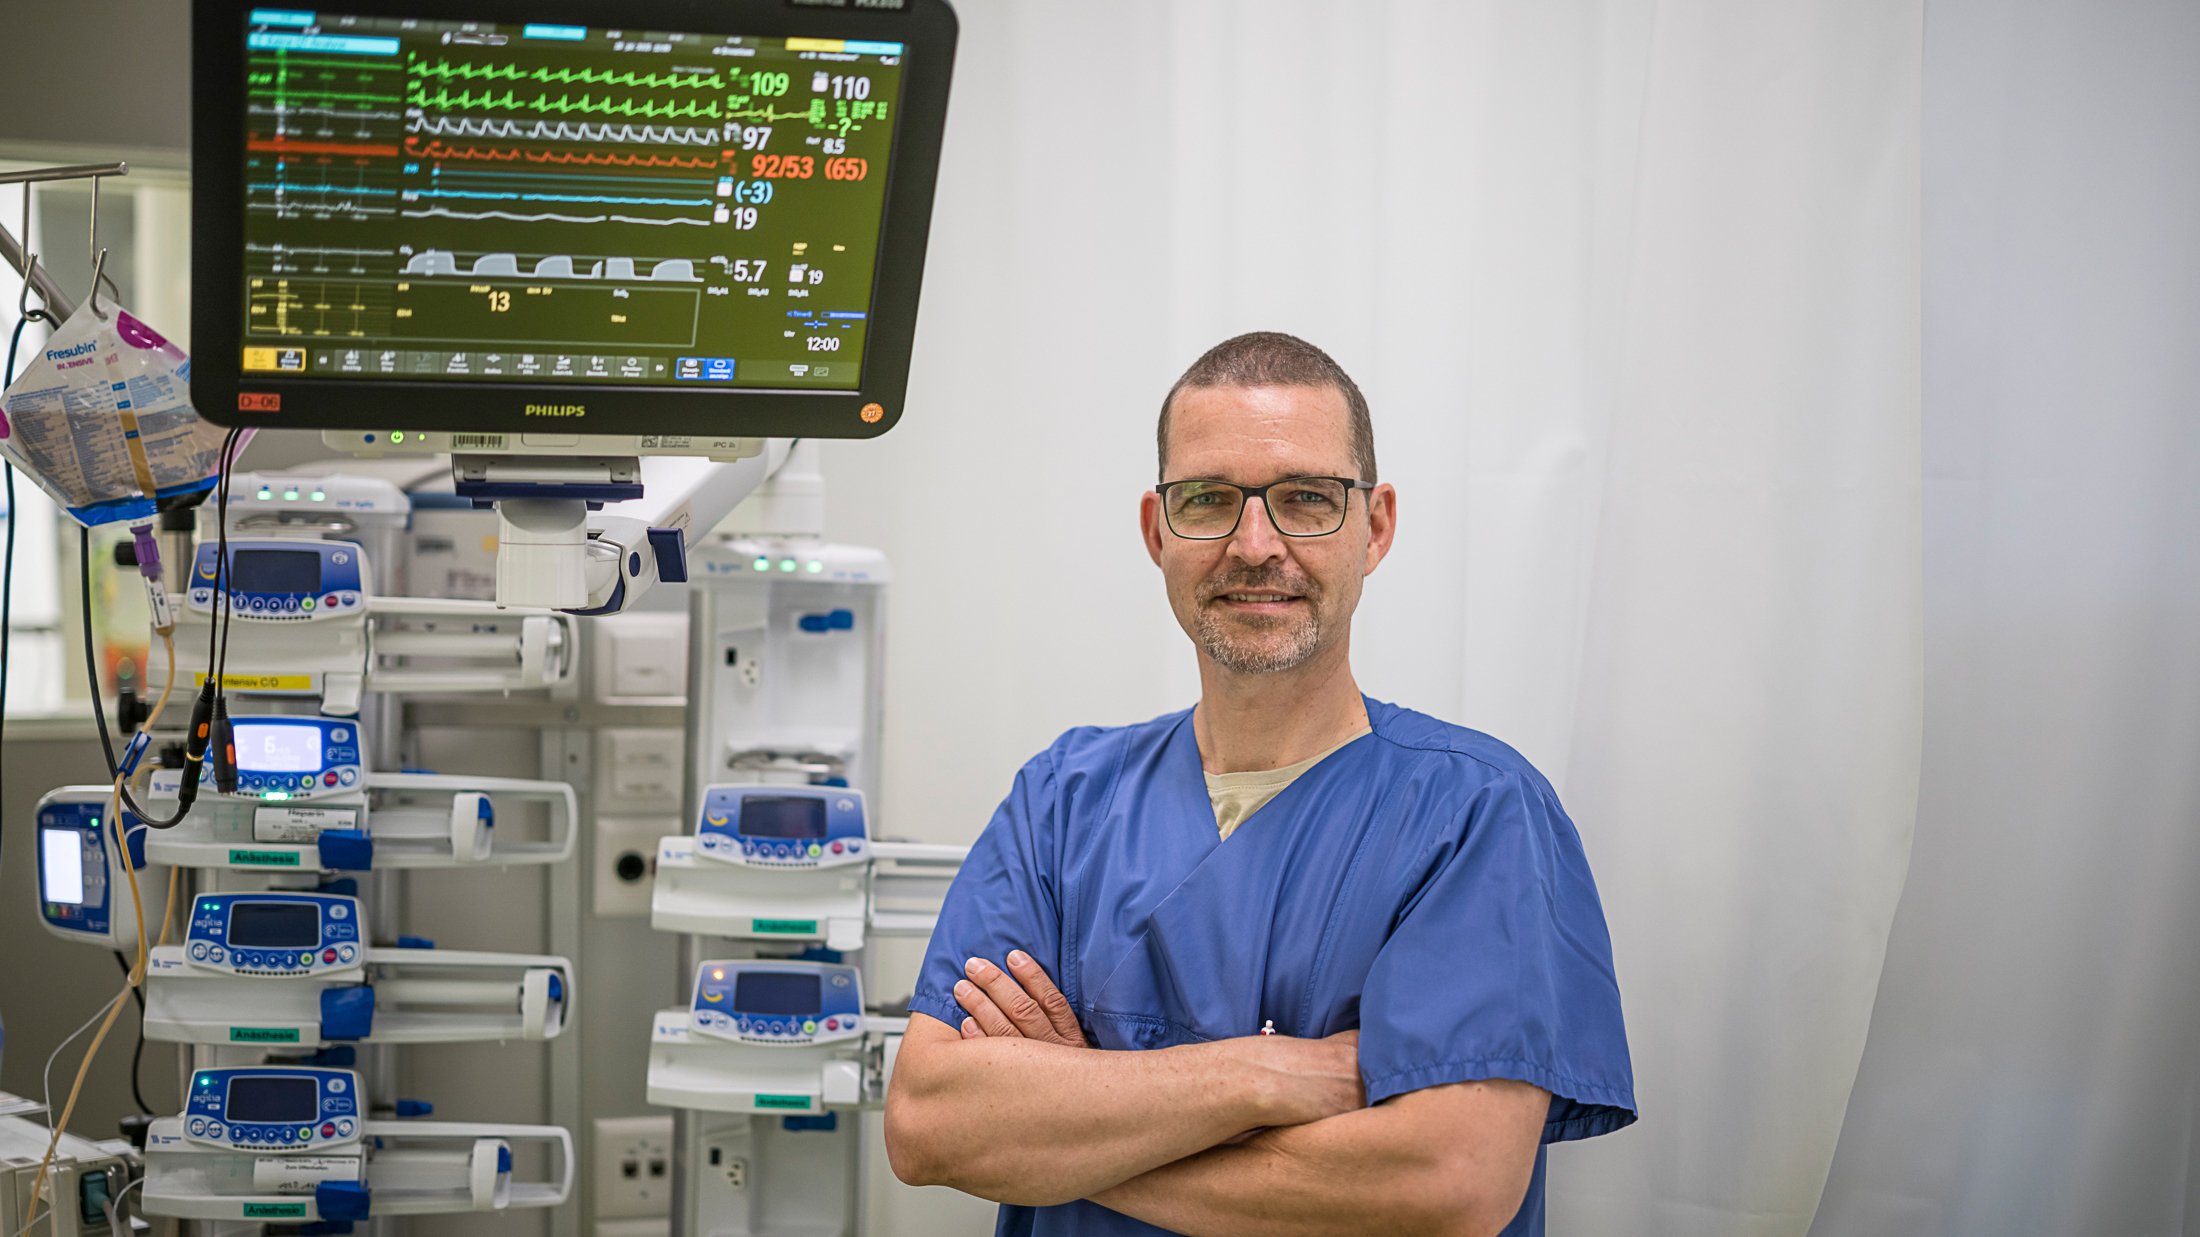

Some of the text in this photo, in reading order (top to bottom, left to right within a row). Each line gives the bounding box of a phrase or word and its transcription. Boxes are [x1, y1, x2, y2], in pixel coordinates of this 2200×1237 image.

[750, 71, 790, 97] 109
[831, 75, 870, 100] 110
[742, 126, 773, 151] 97
[751, 154, 868, 181] 92/53 (65)
[734, 180, 774, 205] (-3)
[733, 206, 758, 230] 19
[733, 259, 768, 283] 5.7
[808, 269, 824, 285] 19
[488, 290, 511, 312] 13
[46, 342, 97, 361] Fresubin
[806, 336, 840, 352] 12:00
[525, 404, 586, 417] PHILIPS
[264, 736, 276, 754] 6
